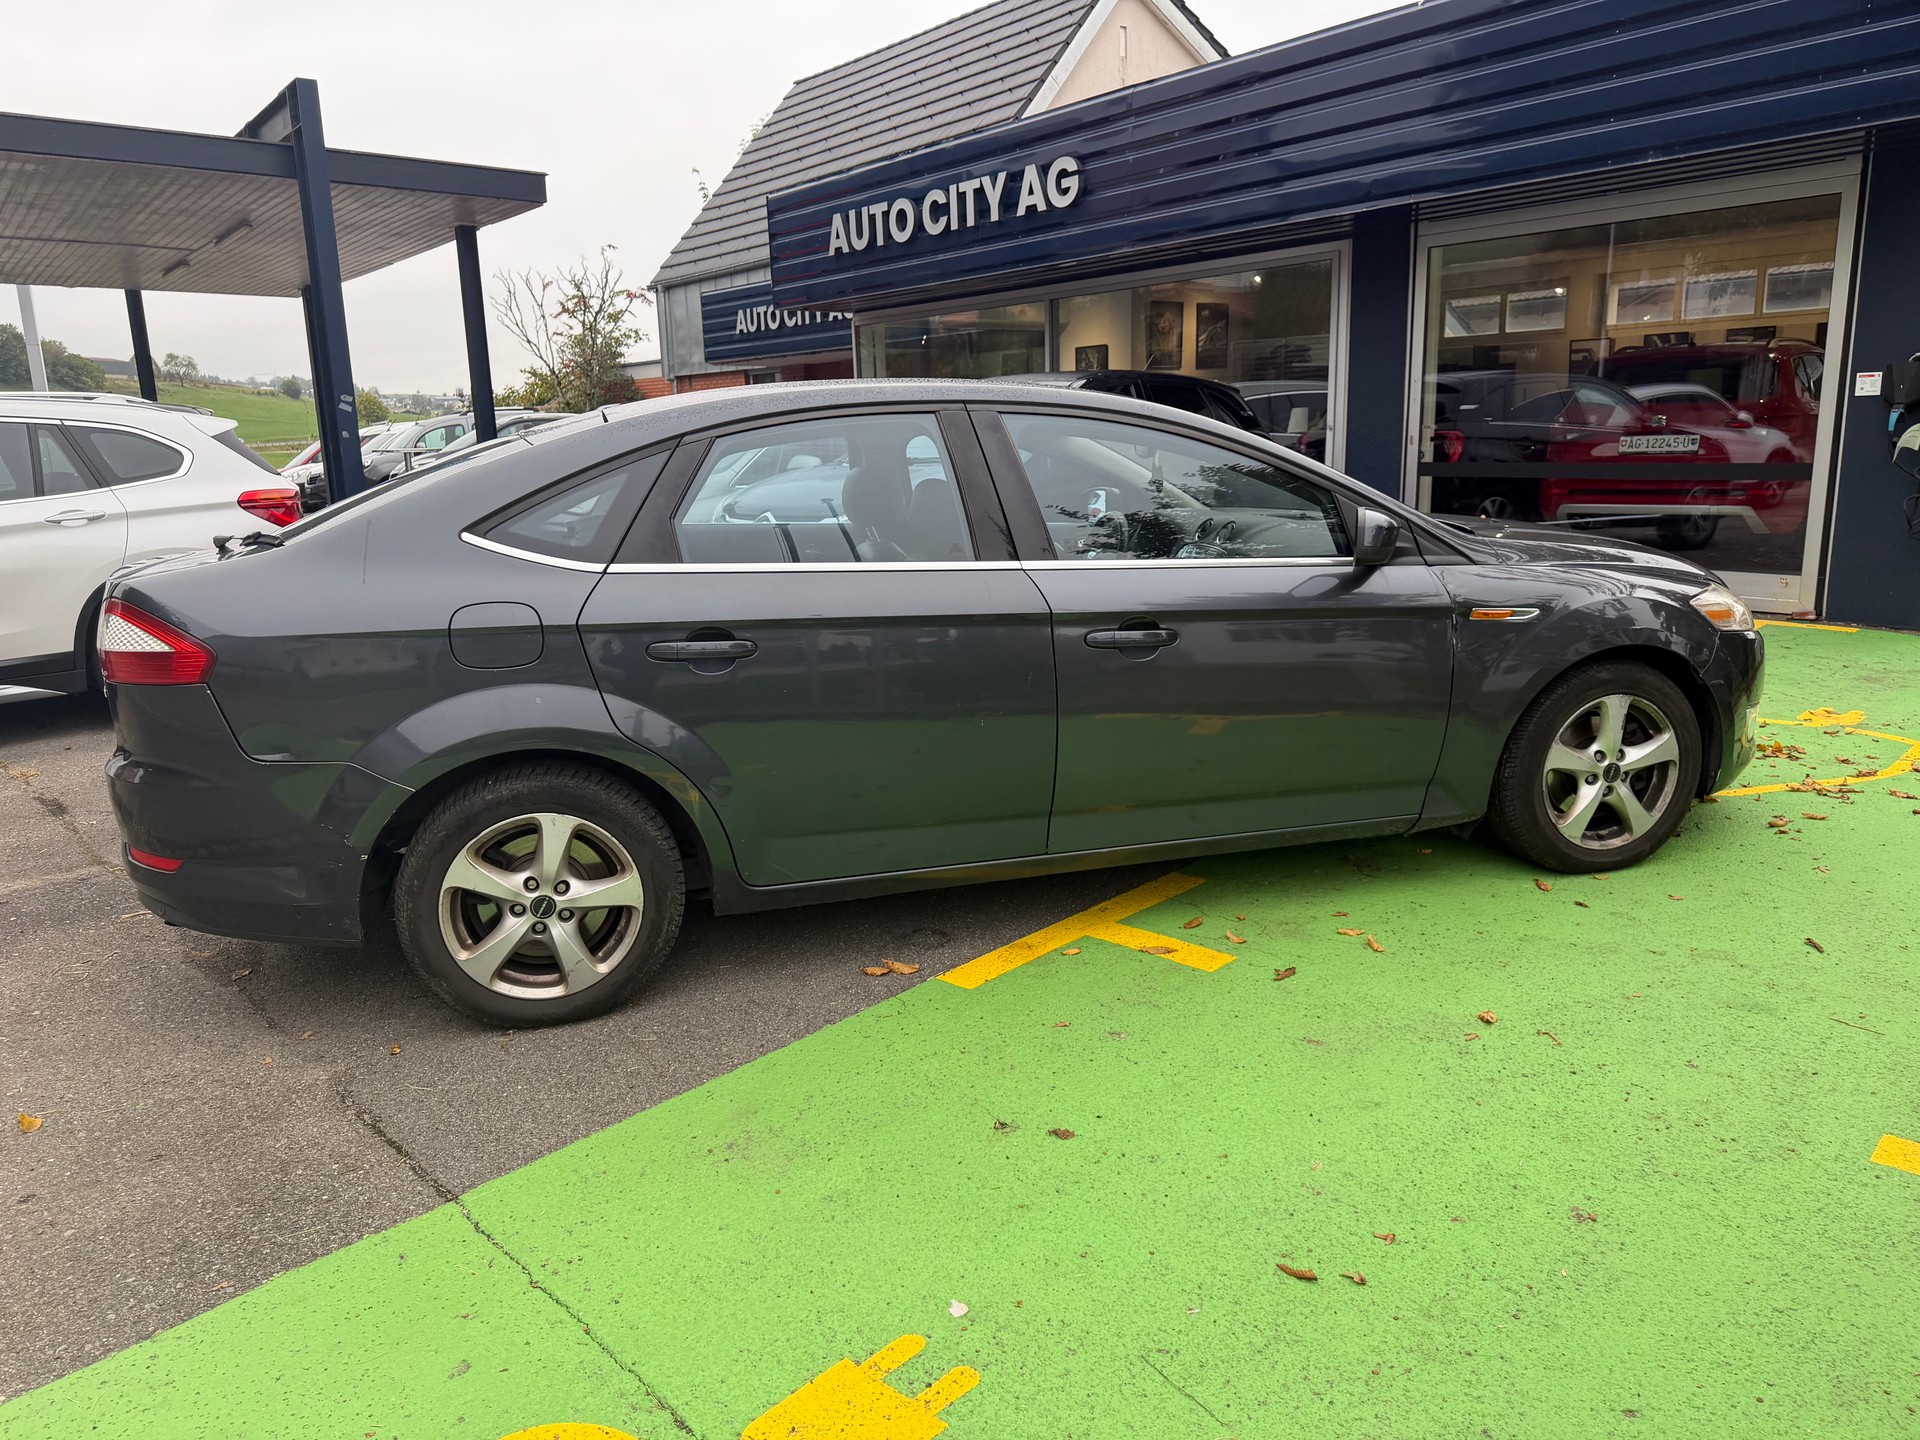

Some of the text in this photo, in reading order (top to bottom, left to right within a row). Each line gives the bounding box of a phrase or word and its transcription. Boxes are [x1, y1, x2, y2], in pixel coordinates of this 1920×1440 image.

[828, 156, 1082, 256] AUTO CITY AG
[736, 304, 781, 334] AUTO
